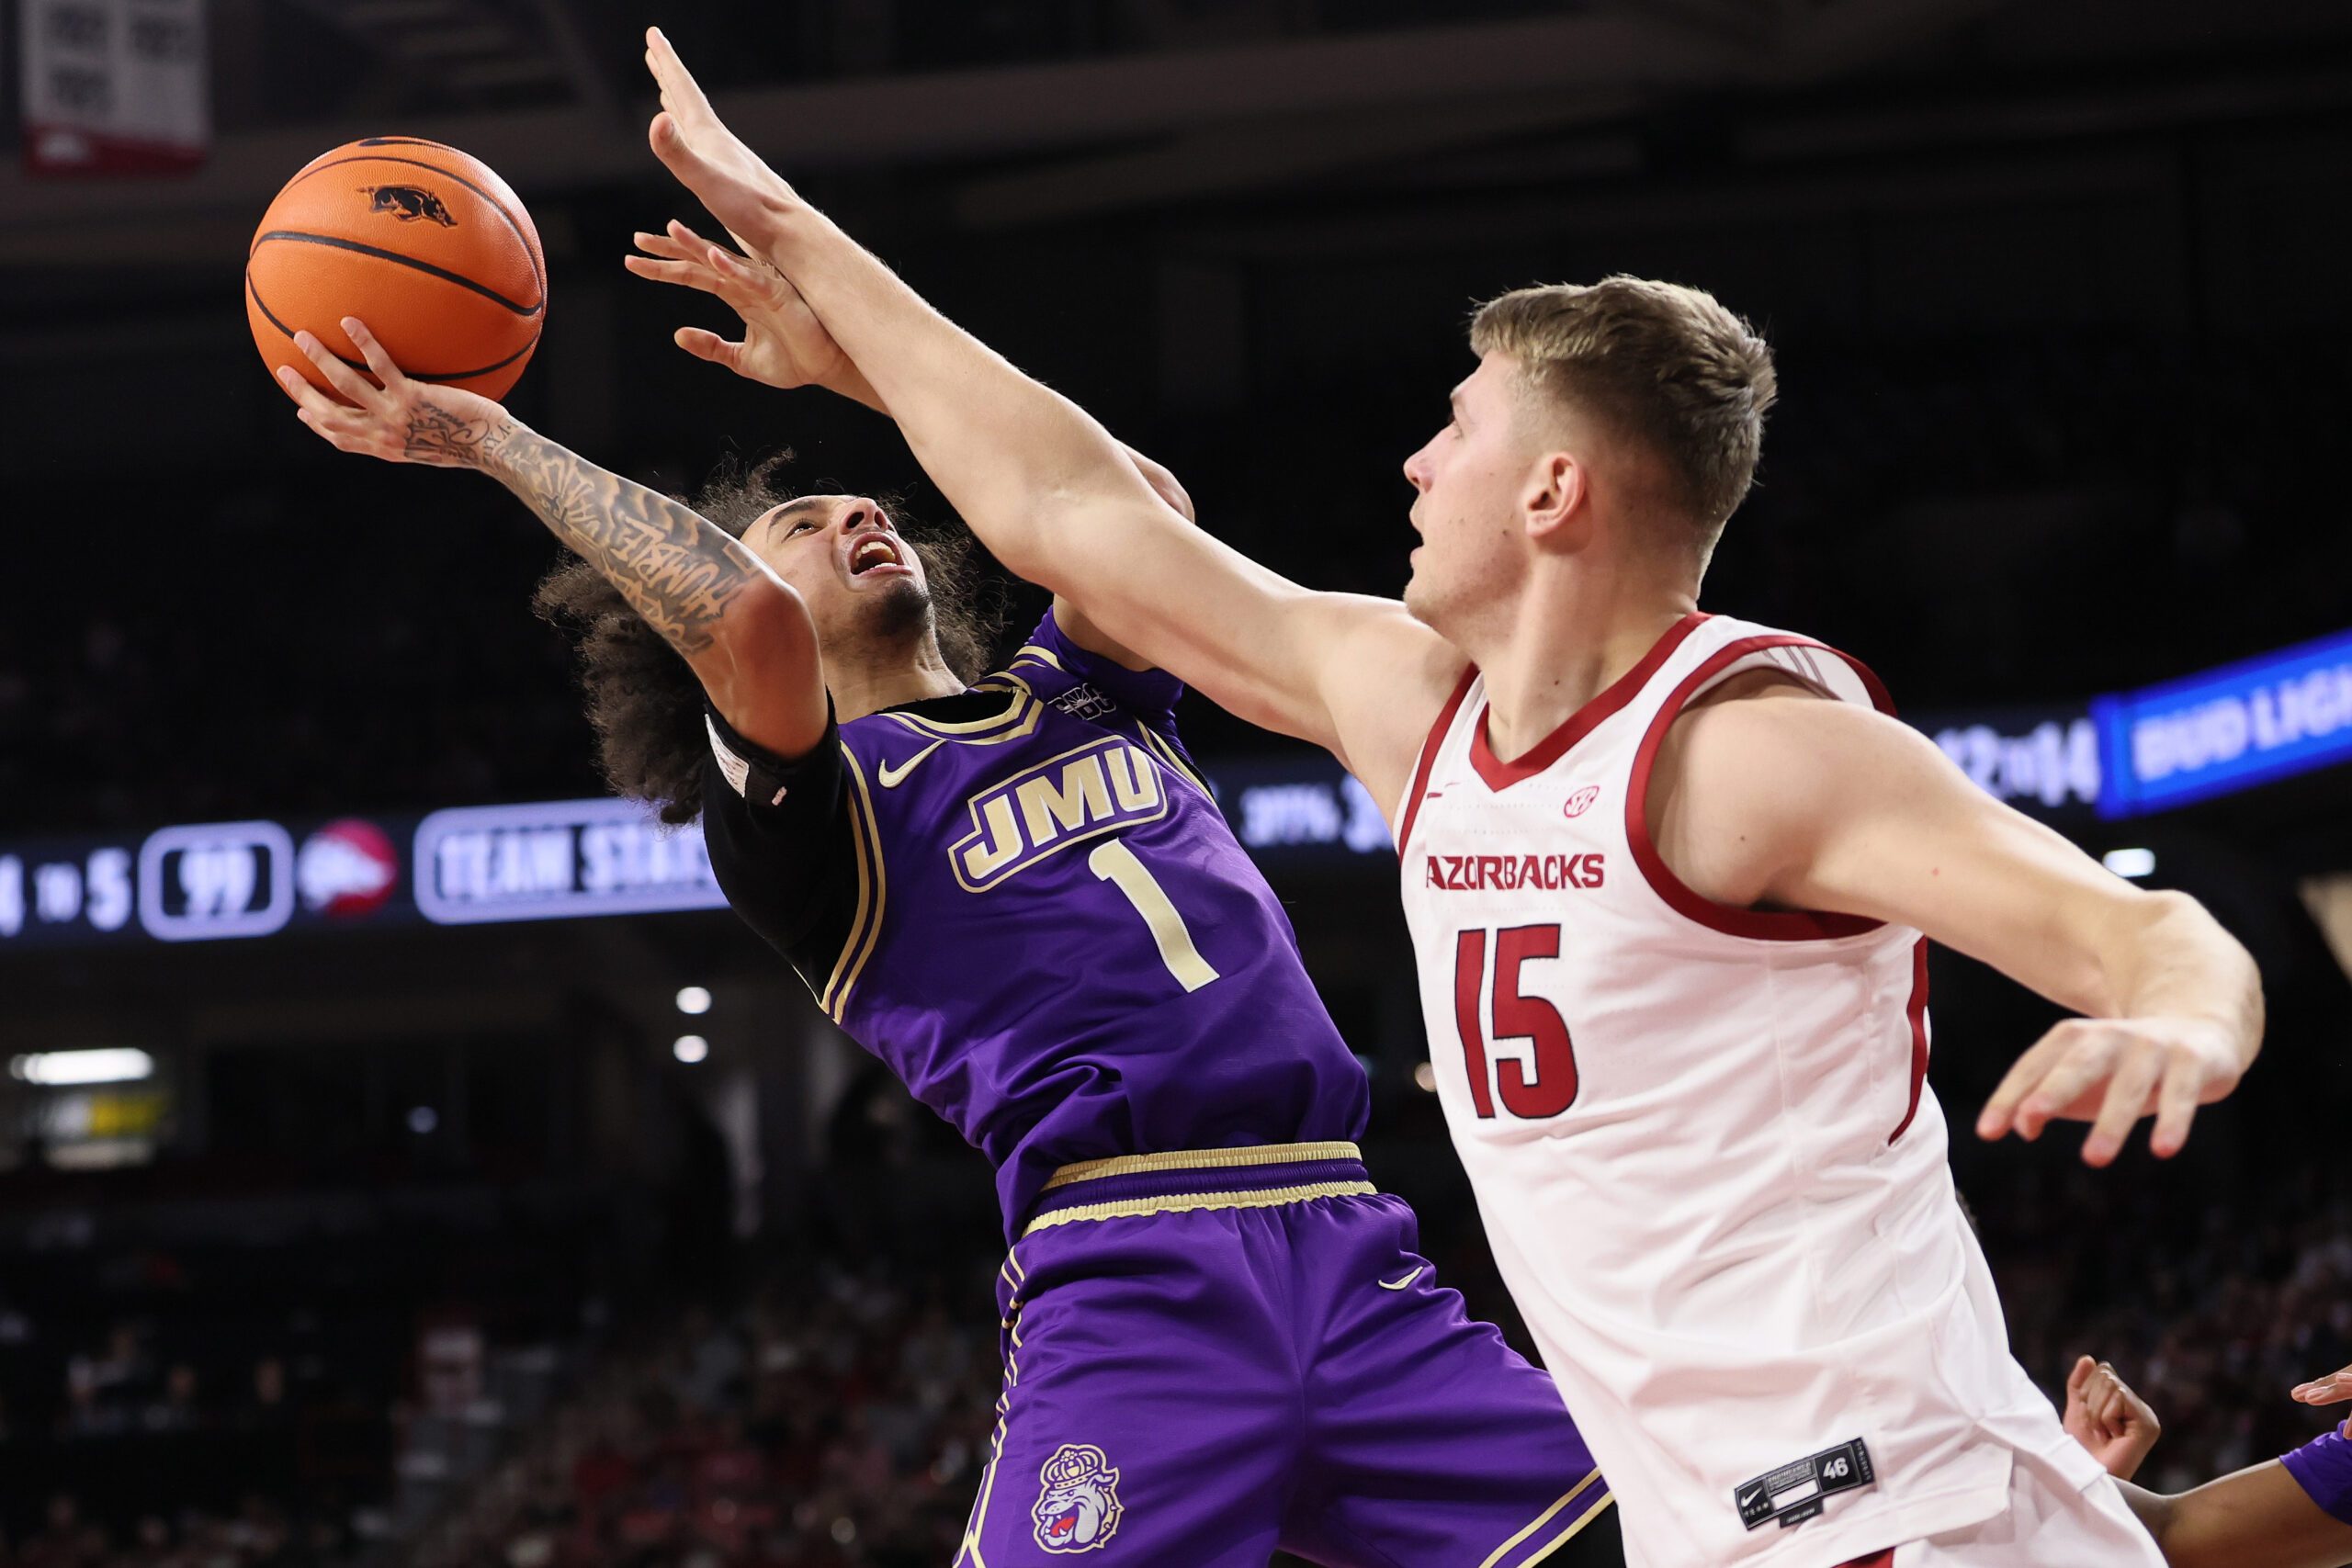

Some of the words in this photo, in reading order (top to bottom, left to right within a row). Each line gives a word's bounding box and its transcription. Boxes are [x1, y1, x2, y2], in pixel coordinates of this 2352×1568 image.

[961, 744, 1162, 880] JMU
[1088, 837, 1220, 993] 1
[1454, 923, 1579, 1120] 15
[1822, 1456, 1849, 1480] 46
